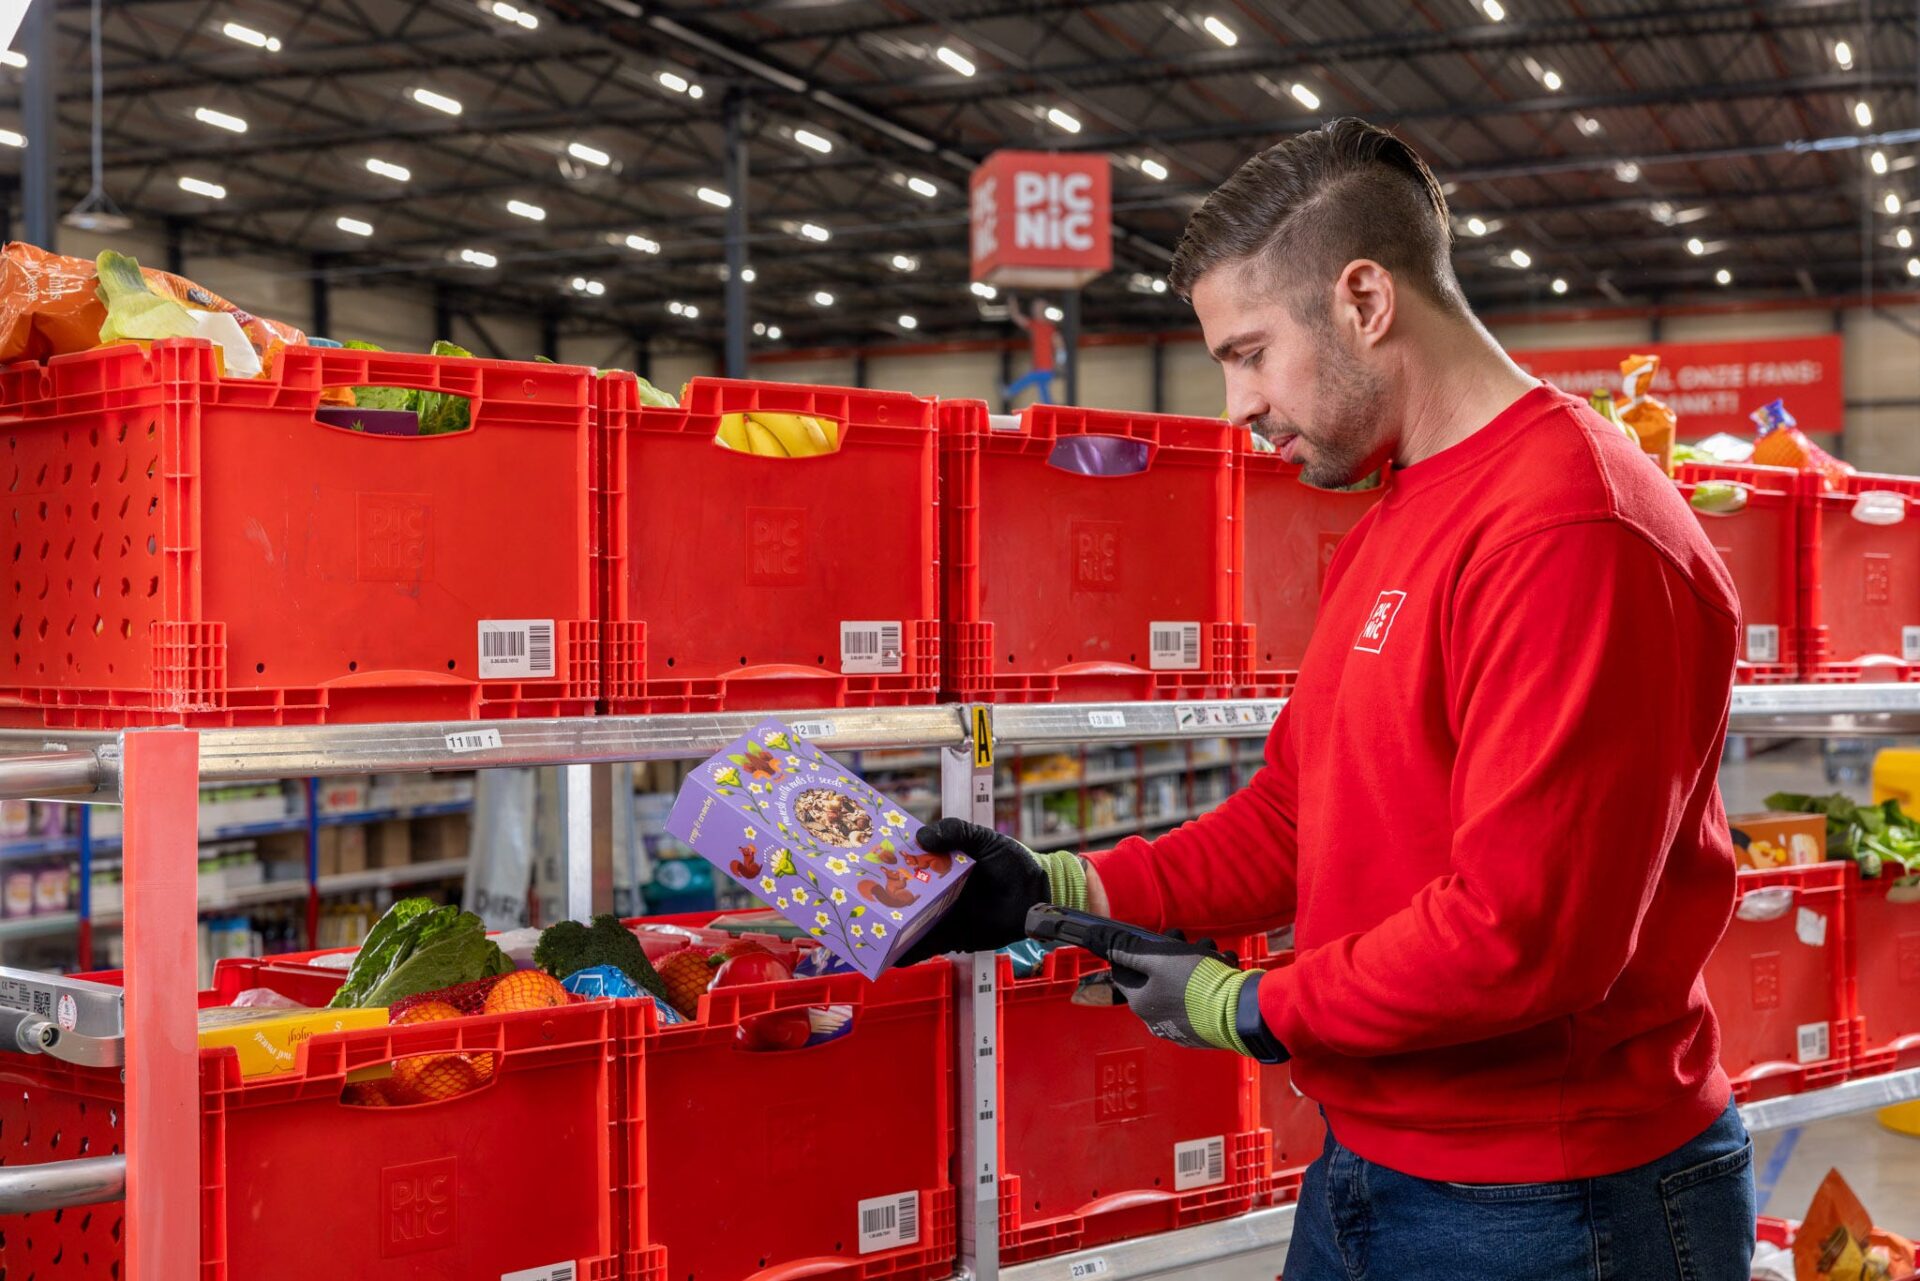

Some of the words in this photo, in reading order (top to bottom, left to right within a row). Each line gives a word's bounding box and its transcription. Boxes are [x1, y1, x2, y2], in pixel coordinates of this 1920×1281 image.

[1014, 171, 1093, 212] PIC
[794, 724, 807, 735] 12
[977, 708, 991, 763] A
[448, 735, 464, 748] 11
[818, 776, 842, 788] seeds
[979, 782, 985, 791] 2
[981, 972, 987, 981] 5
[288, 1026, 313, 1046] njoy!
[983, 1035, 988, 1045] 6
[983, 1099, 989, 1108] 7
[392, 1175, 448, 1211] PIC
[1072, 1264, 1085, 1277] 23
